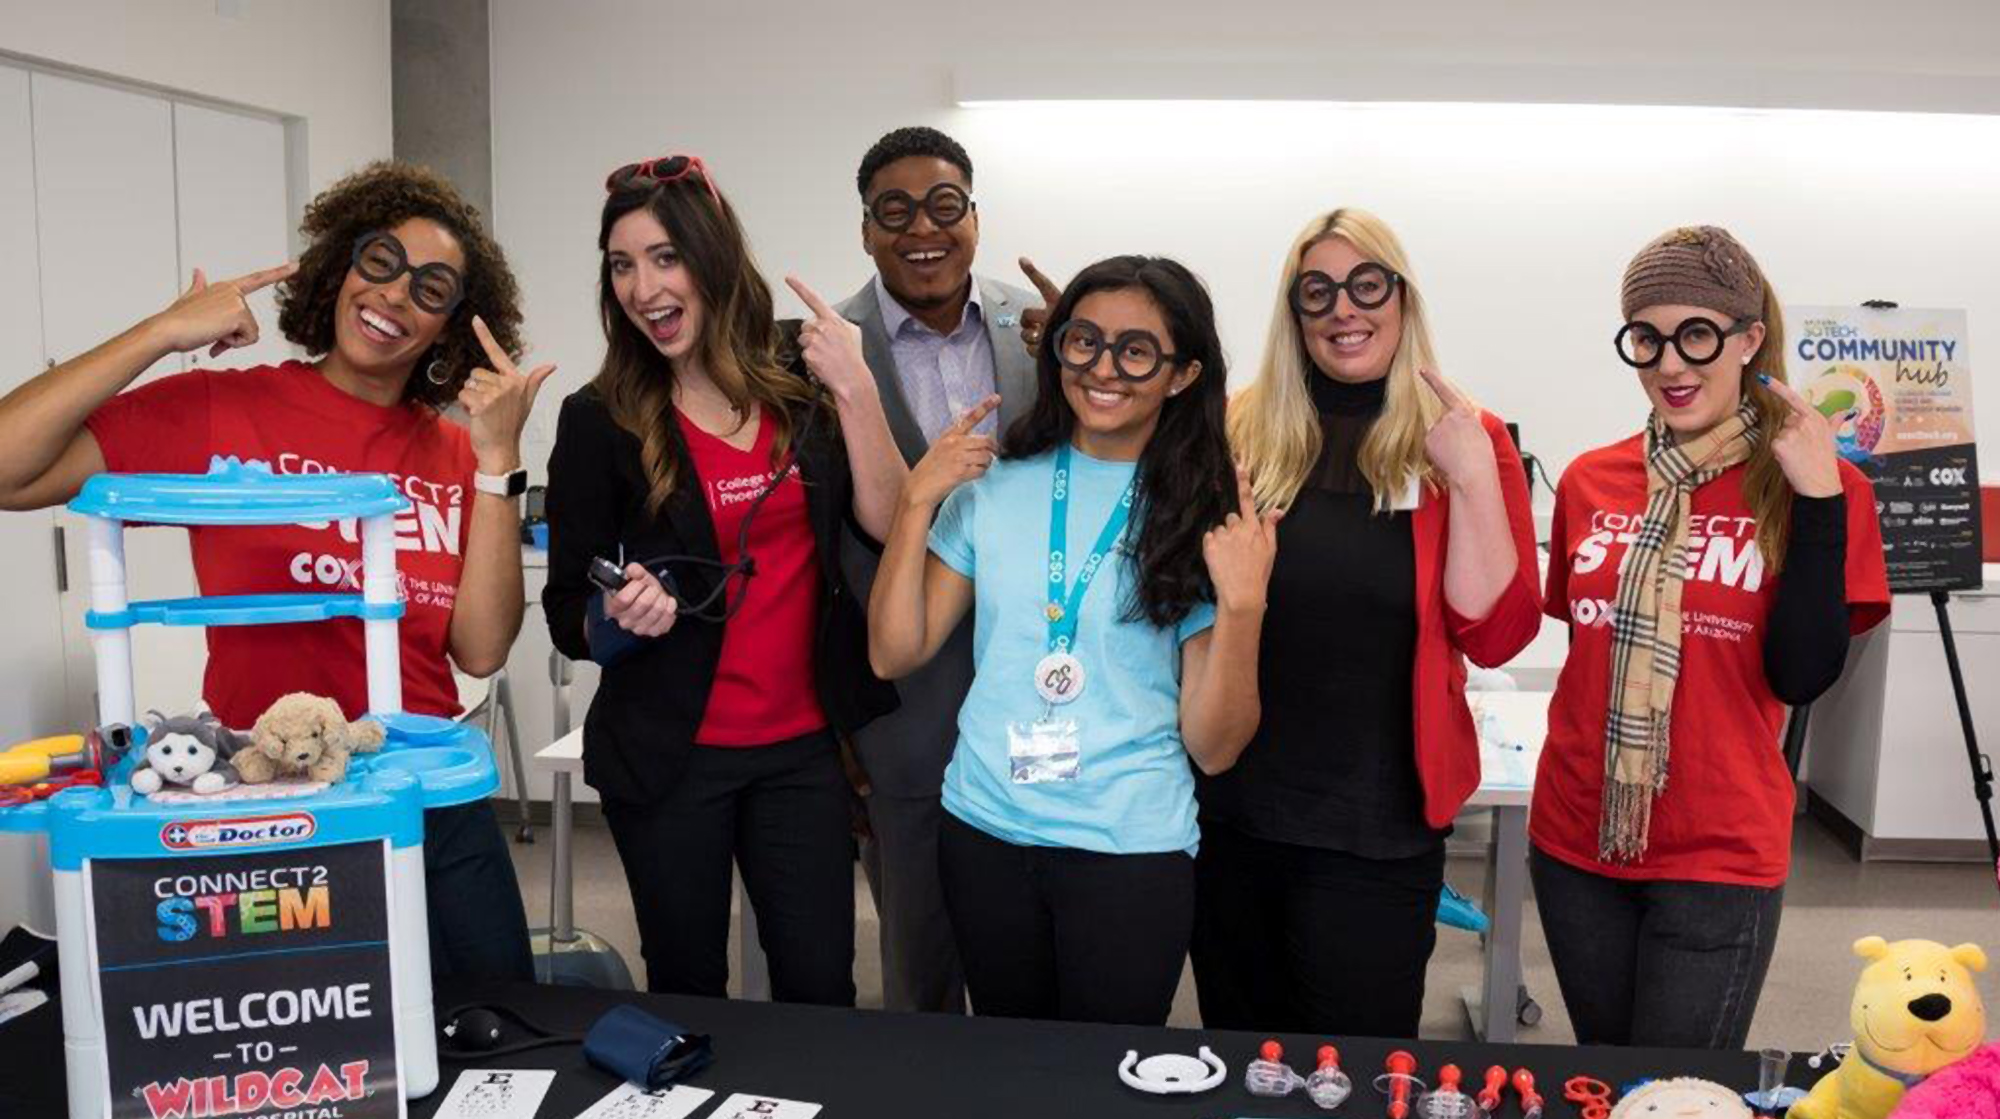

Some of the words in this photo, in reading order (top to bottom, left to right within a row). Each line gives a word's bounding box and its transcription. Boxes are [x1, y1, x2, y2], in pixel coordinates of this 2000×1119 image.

[1798, 338, 1956, 361] COMMUNITY
[1895, 359, 1949, 388] hub
[1929, 467, 1967, 487] COX
[290, 551, 364, 591] COX
[218, 822, 308, 844] Doctor
[154, 865, 329, 898] CONNECT2
[156, 886, 332, 943] STEM
[133, 983, 372, 1040] WELCOME
[142, 1059, 370, 1119] WILDCAT
